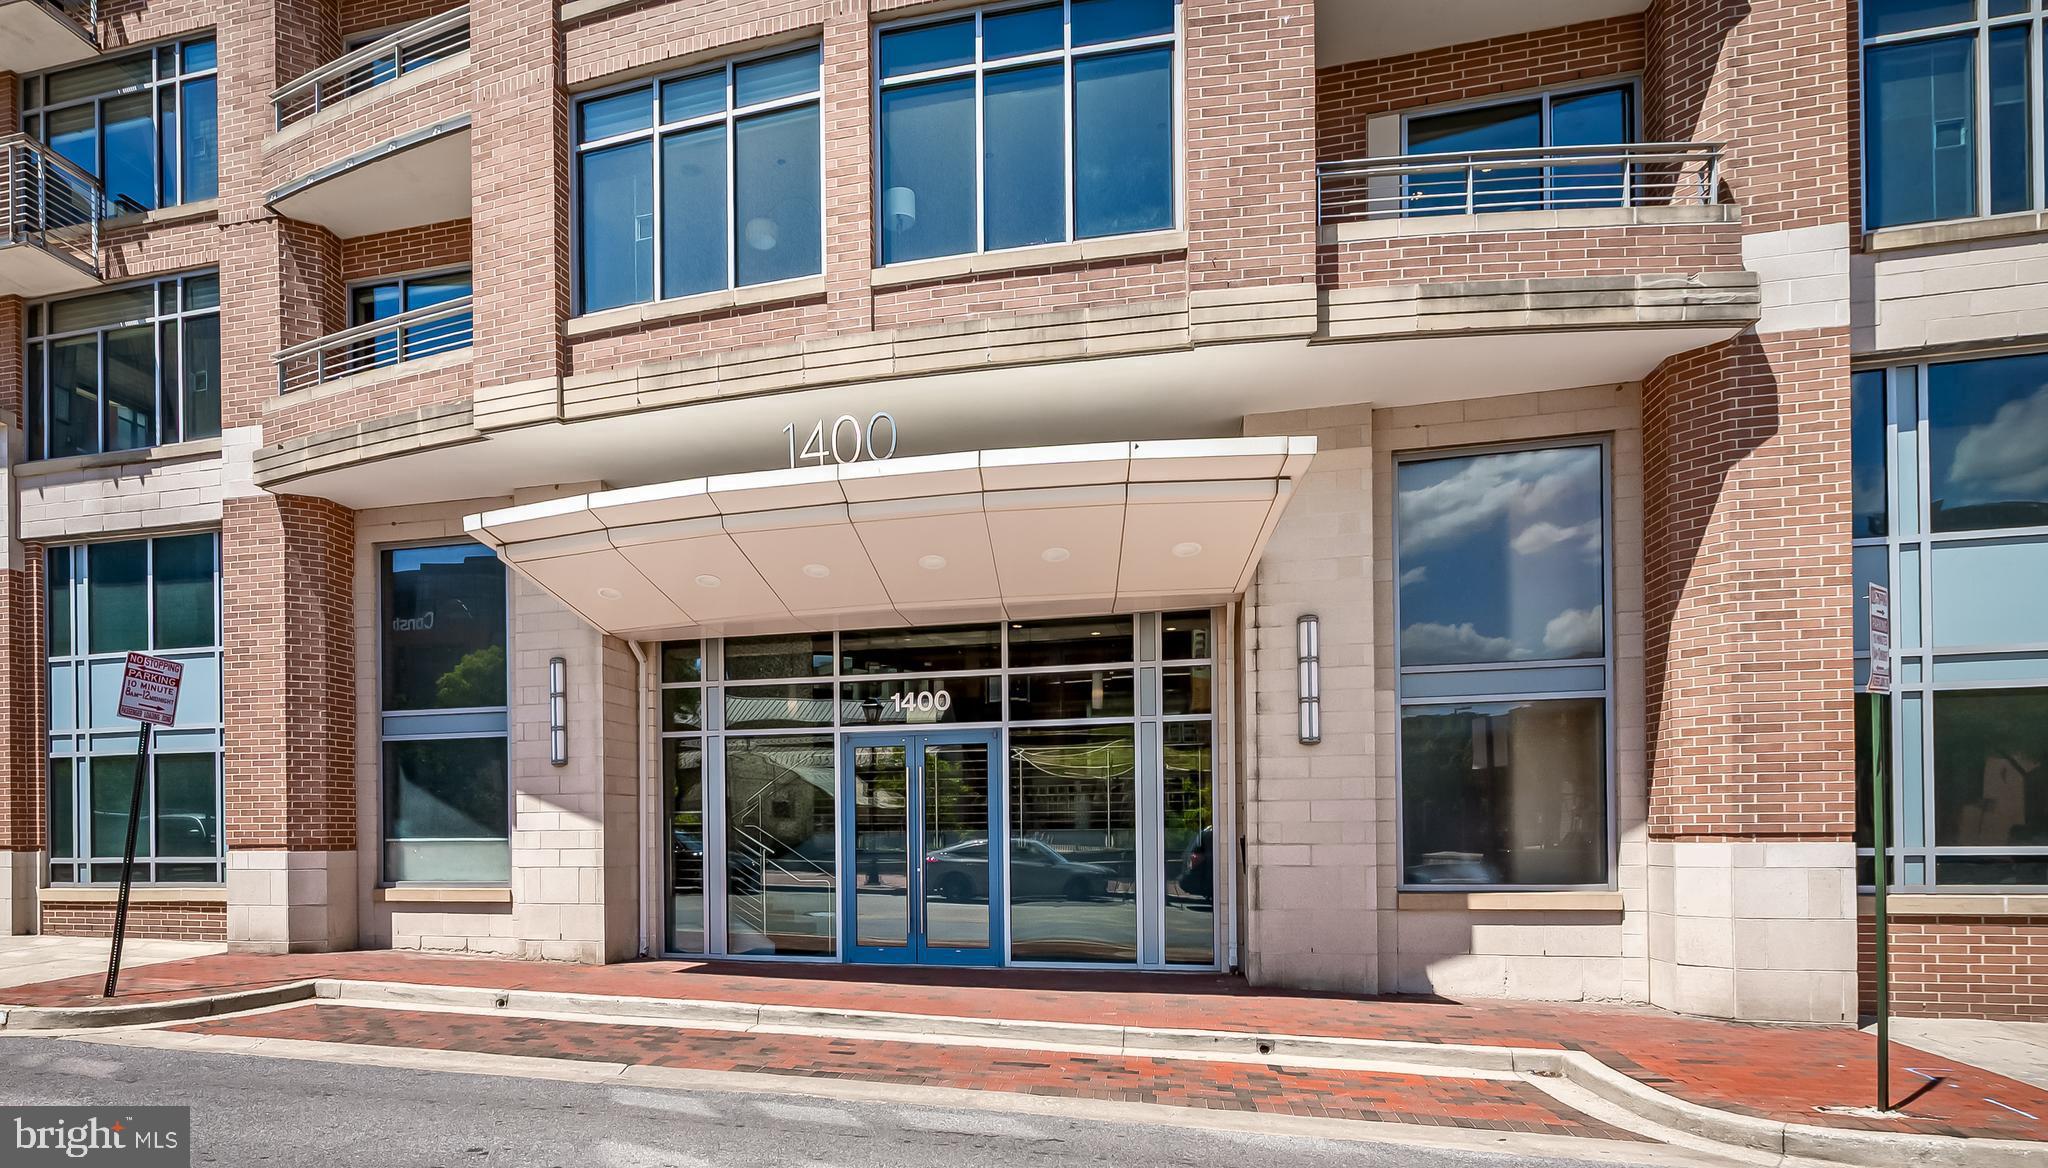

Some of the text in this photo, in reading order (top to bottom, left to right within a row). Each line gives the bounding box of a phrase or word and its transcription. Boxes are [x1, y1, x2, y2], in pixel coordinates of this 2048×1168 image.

[782, 411, 897, 469] 1400
[129, 654, 180, 673] NO STOPPING
[127, 679, 174, 695] 10 MINUTE
[128, 669, 176, 686] PARKING
[890, 690, 951, 712] 1400
